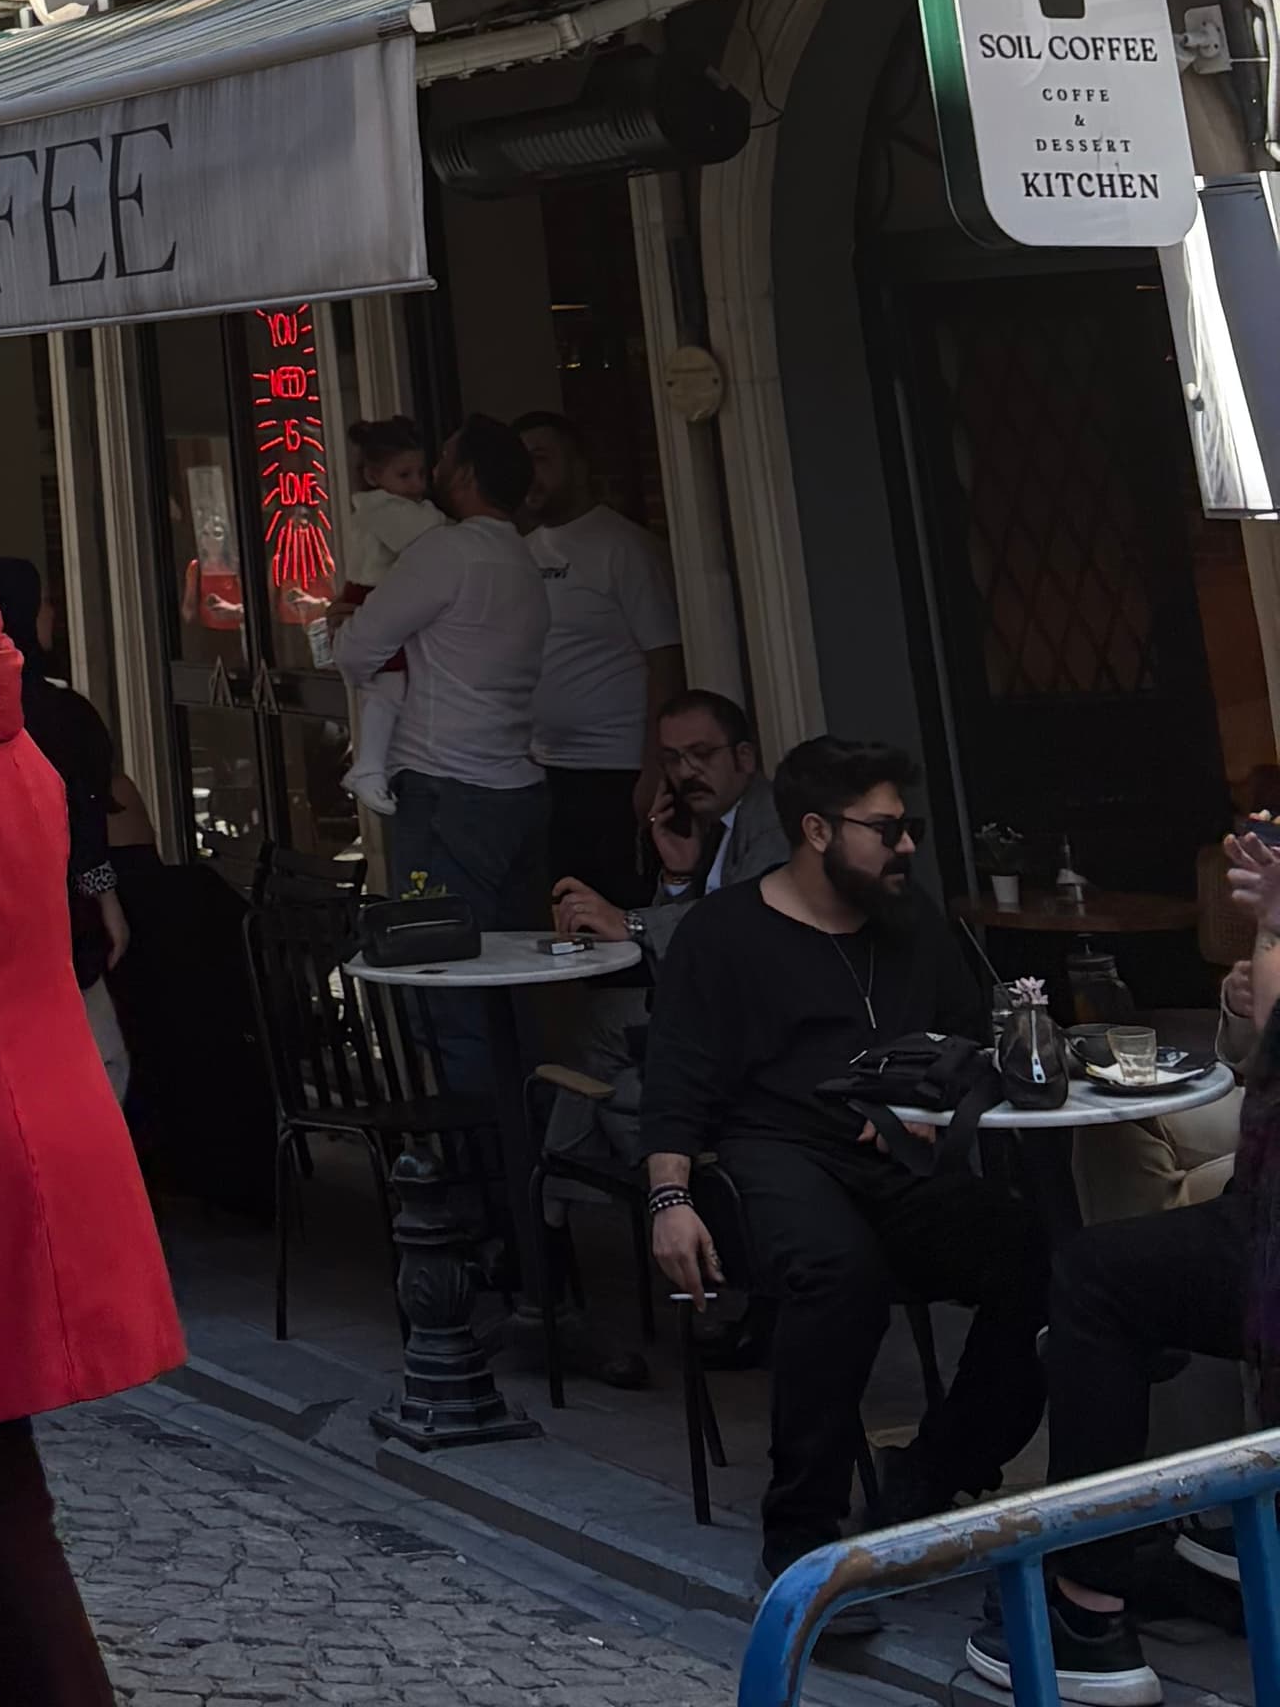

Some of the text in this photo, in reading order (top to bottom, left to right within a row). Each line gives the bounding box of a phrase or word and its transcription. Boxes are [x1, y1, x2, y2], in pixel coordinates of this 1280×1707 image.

[978, 33, 1159, 63] SOIL COFFEE
[1042, 88, 1111, 103] COFFE
[1073, 114, 1086, 127] &
[1035, 138, 1132, 153] DESSERT
[1020, 172, 1160, 200] KITCHEN
[268, 312, 298, 347] YOU
[278, 472, 320, 506] LOVE
